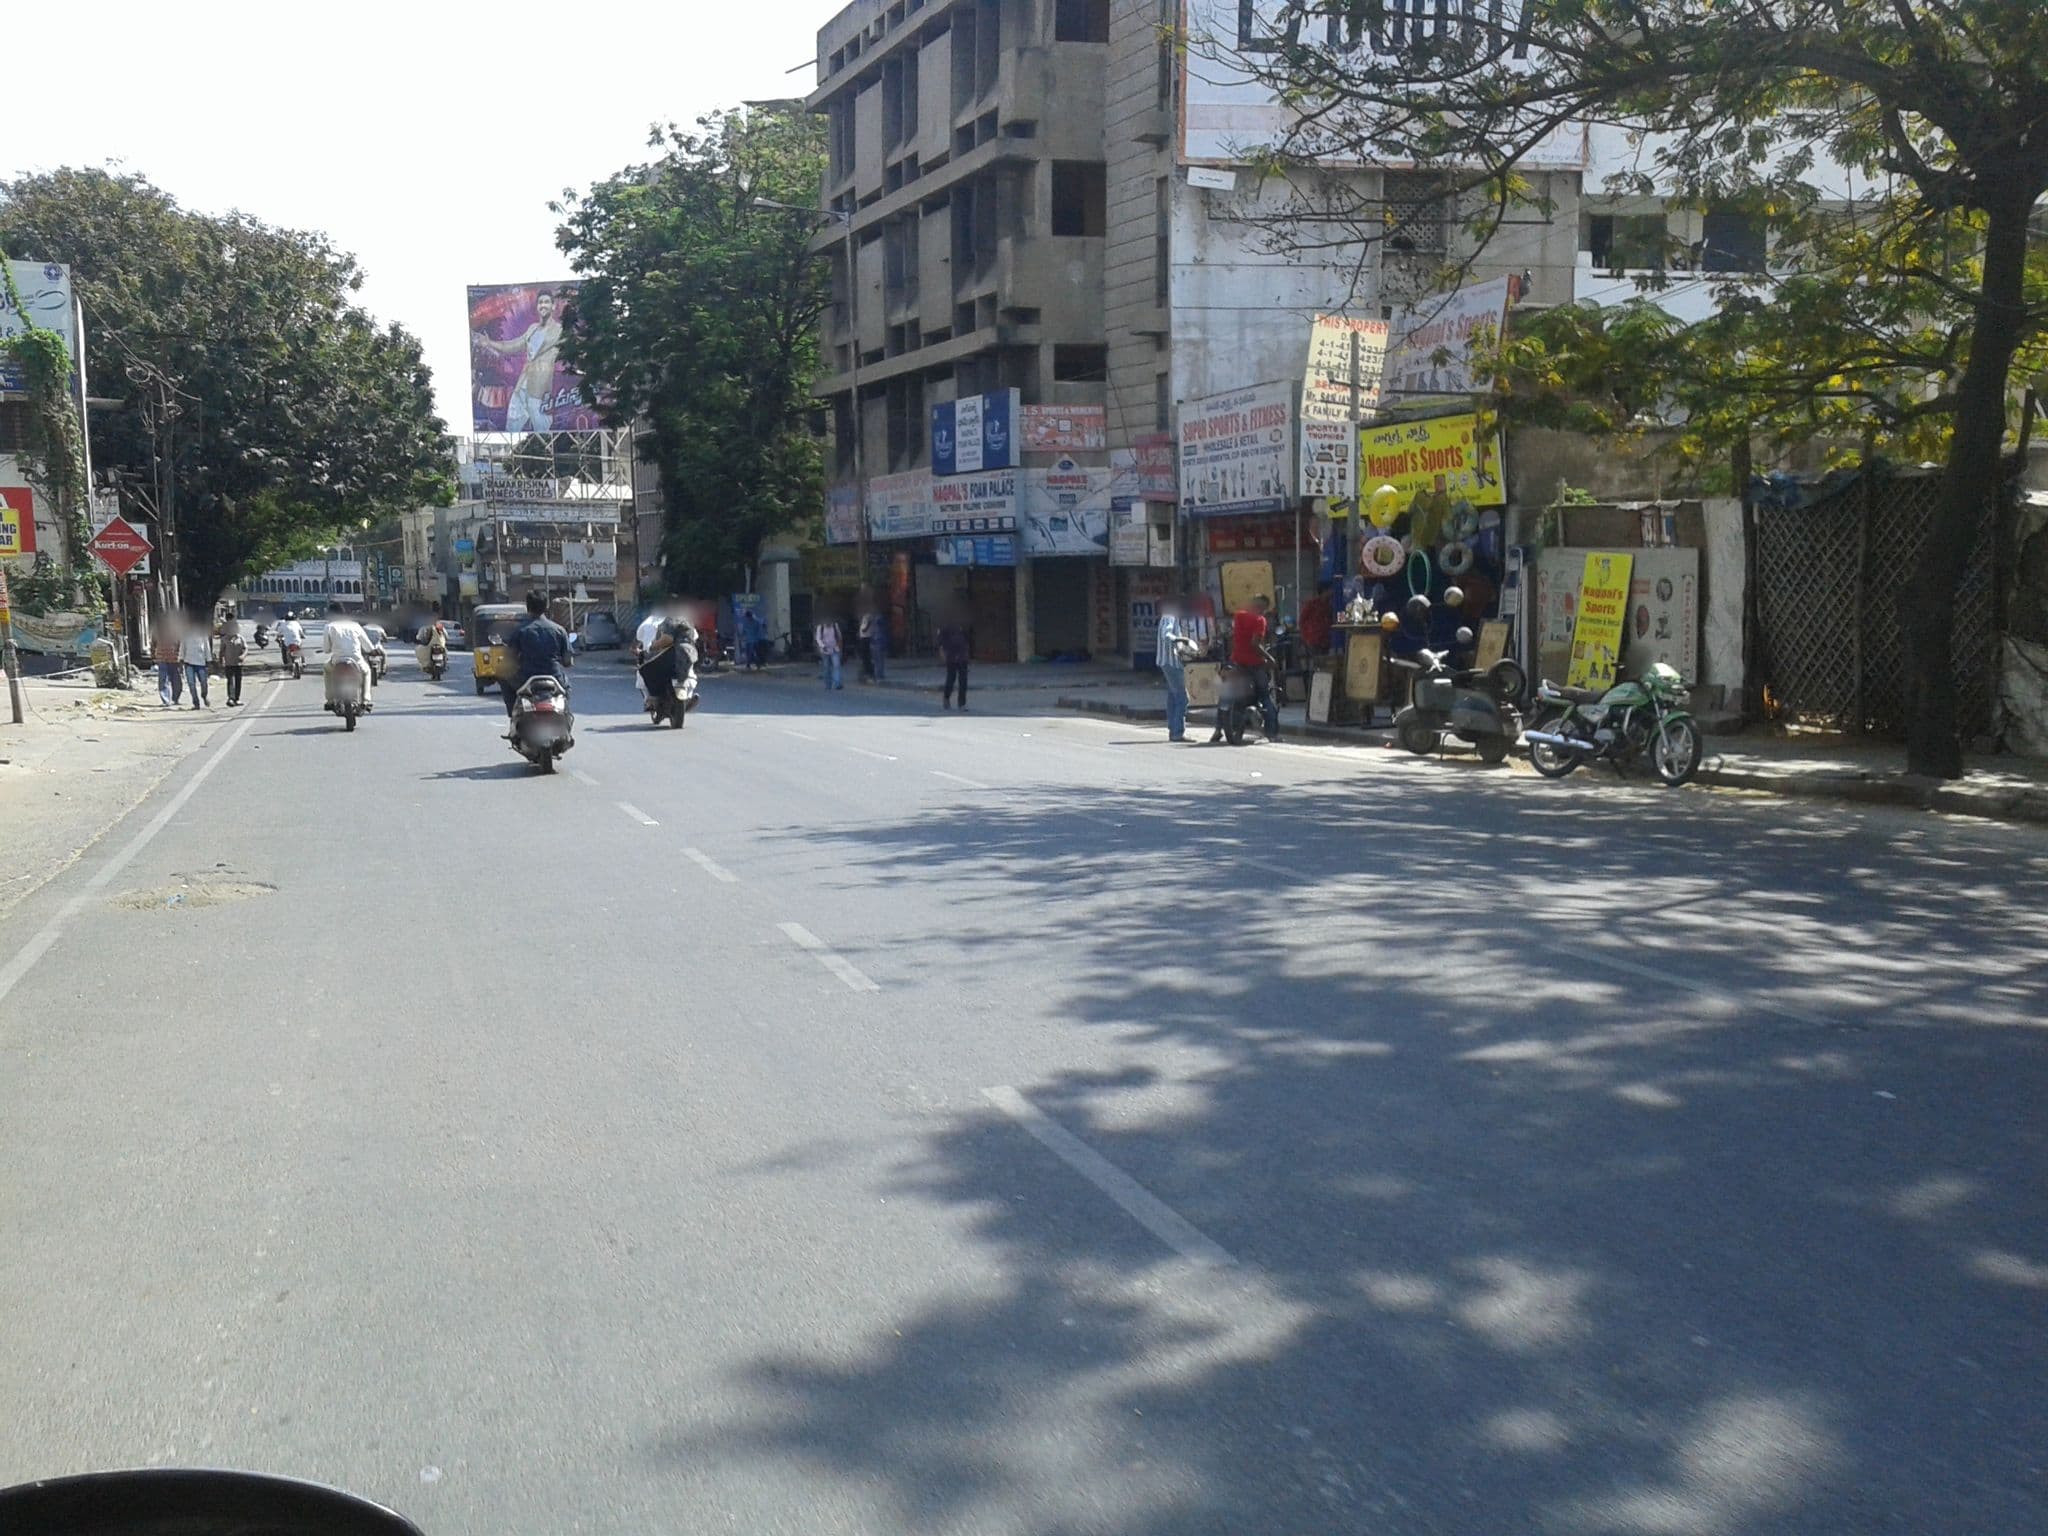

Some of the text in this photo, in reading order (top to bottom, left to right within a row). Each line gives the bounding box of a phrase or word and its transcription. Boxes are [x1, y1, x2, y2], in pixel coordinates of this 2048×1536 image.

[1208, 412, 1240, 438] SPORTS
[1250, 403, 1286, 431] FITNESS
[1368, 445, 1464, 479] Nagpal's Sports
[487, 480, 549, 489] RAMAKRISHNA
[933, 482, 968, 502] NAGPAL'S
[970, 480, 988, 499] FOAM
[989, 478, 1015, 497] PALACE
[1583, 586, 1624, 600] Nagpal's
[1585, 601, 1616, 615] Sports
